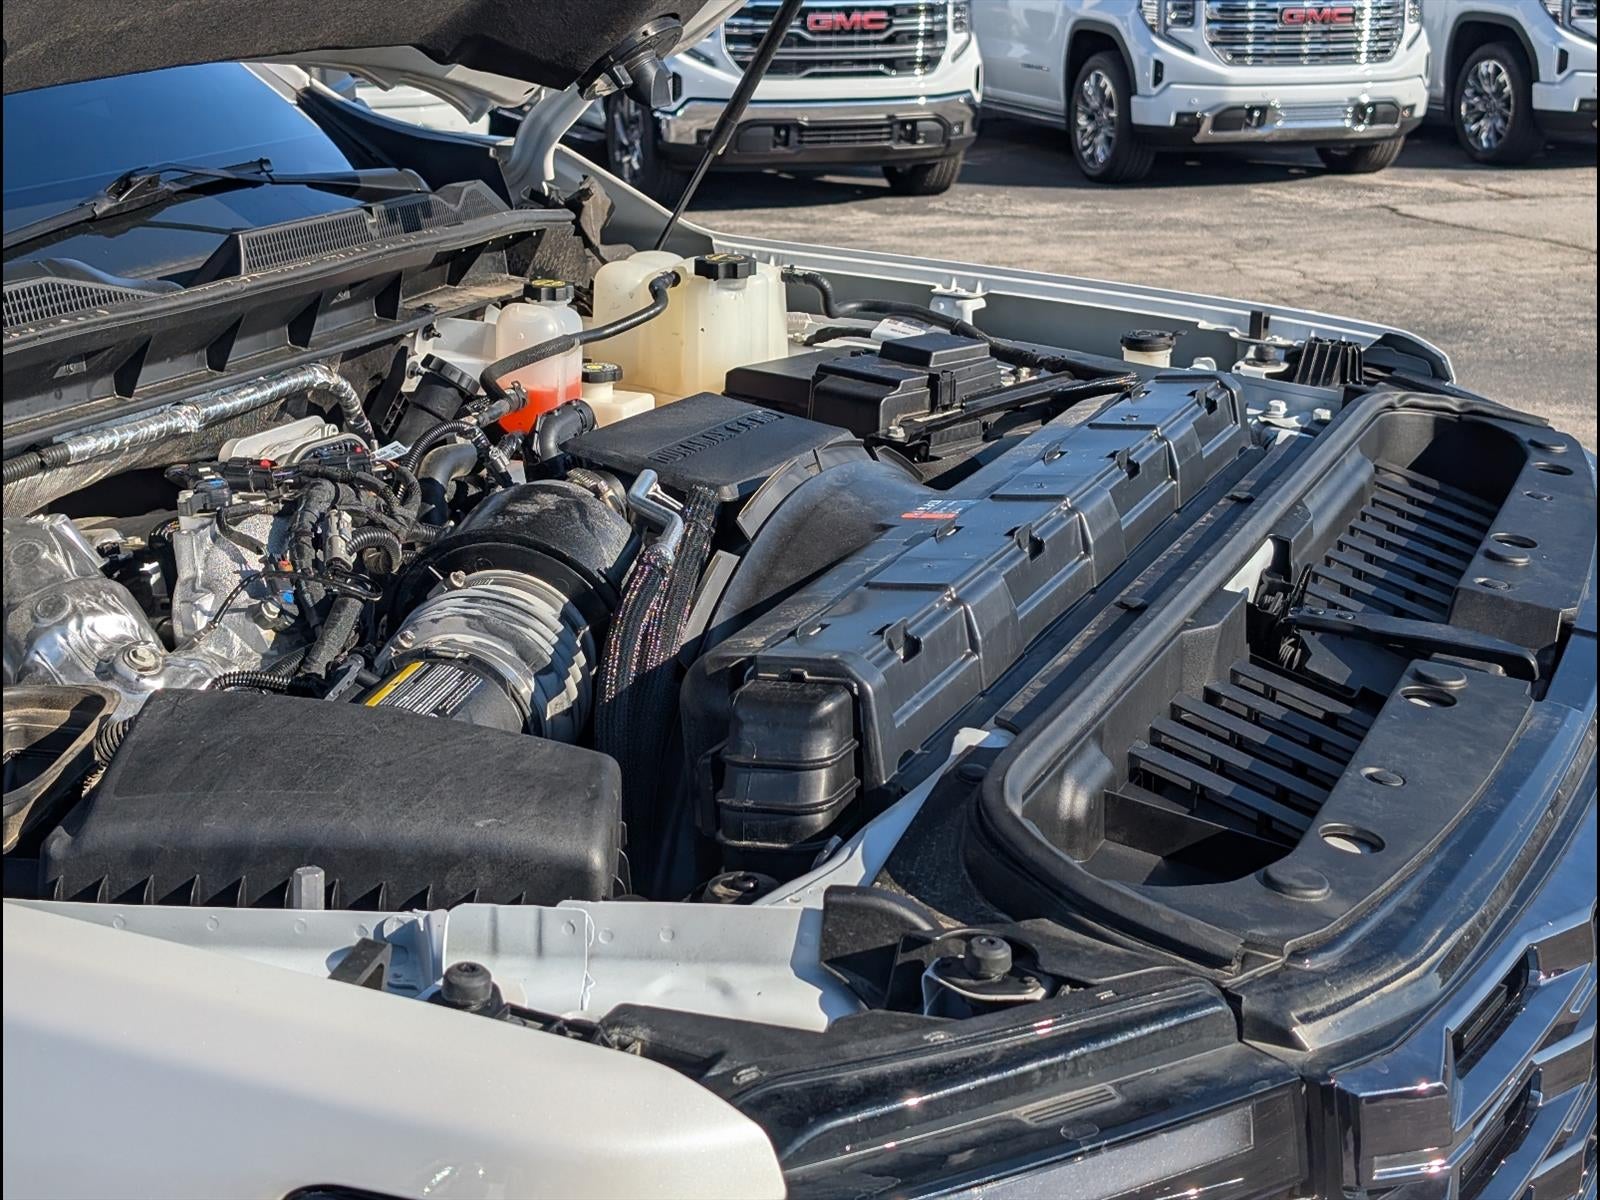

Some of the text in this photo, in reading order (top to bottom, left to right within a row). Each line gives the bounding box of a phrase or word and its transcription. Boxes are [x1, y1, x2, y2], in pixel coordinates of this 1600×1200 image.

[807, 11, 888, 31] GMC
[1282, 7, 1355, 24] GMC
[647, 429, 736, 464] DURAMAX
